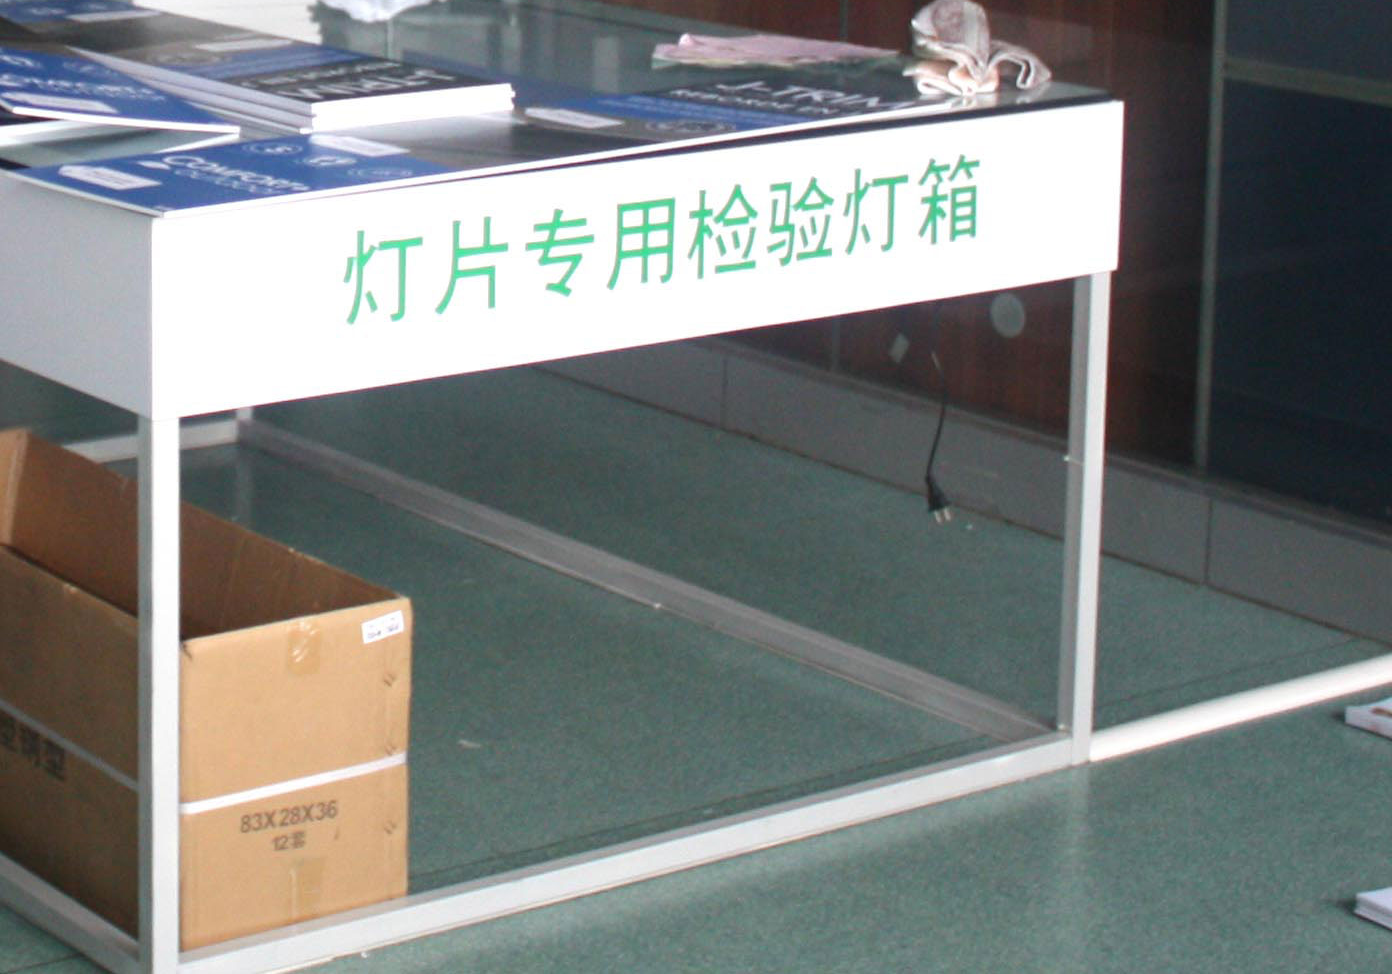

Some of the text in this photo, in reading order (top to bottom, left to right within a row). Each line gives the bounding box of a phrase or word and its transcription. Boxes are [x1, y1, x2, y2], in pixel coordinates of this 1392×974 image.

[343, 154, 981, 326] 灯片专用检验灯箱
[240, 800, 337, 834] 83X28X36
